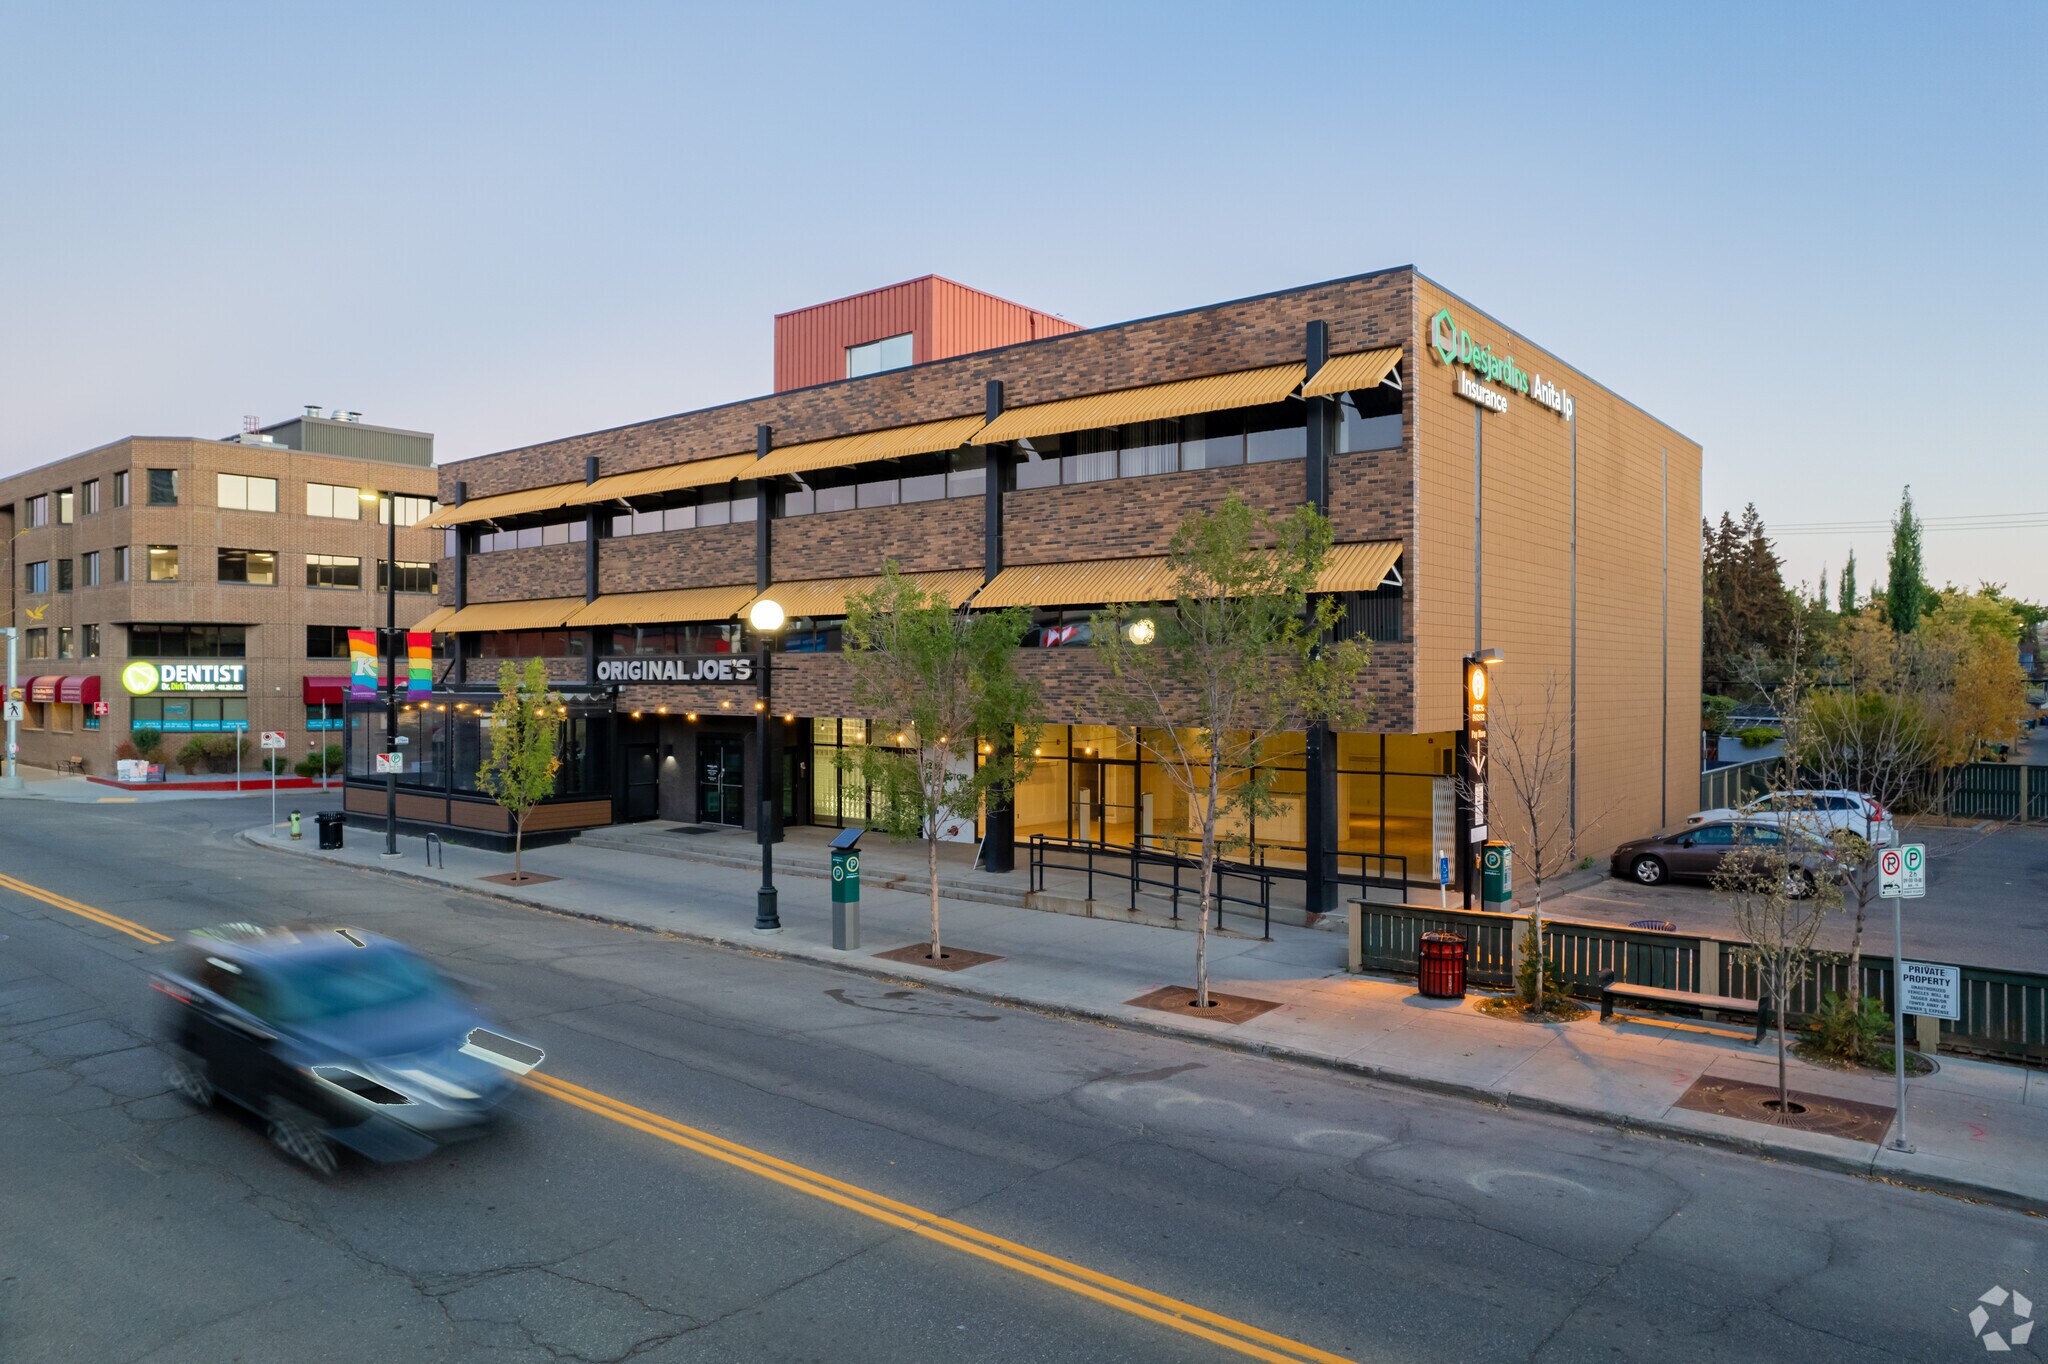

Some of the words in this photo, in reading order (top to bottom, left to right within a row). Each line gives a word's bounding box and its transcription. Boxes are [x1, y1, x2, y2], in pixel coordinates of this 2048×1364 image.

[1461, 329, 1529, 394] Desjardins
[1533, 374, 1561, 411] Anita
[1562, 388, 1573, 421] Ip
[1461, 370, 1508, 413] Insurance
[161, 664, 243, 682] DENTIST
[355, 657, 376, 677] K
[597, 660, 691, 681] ORIGINAL
[692, 658, 753, 681] JOE'S
[161, 683, 170, 691] Dr.
[171, 683, 184, 691] Dirk
[184, 682, 215, 692] Thompson
[1910, 852, 1918, 866] P
[1908, 966, 1946, 976] PRIVATE
[1903, 974, 1951, 987] PROPERTY
[1910, 985, 1946, 993] UNAUTHORIZED
